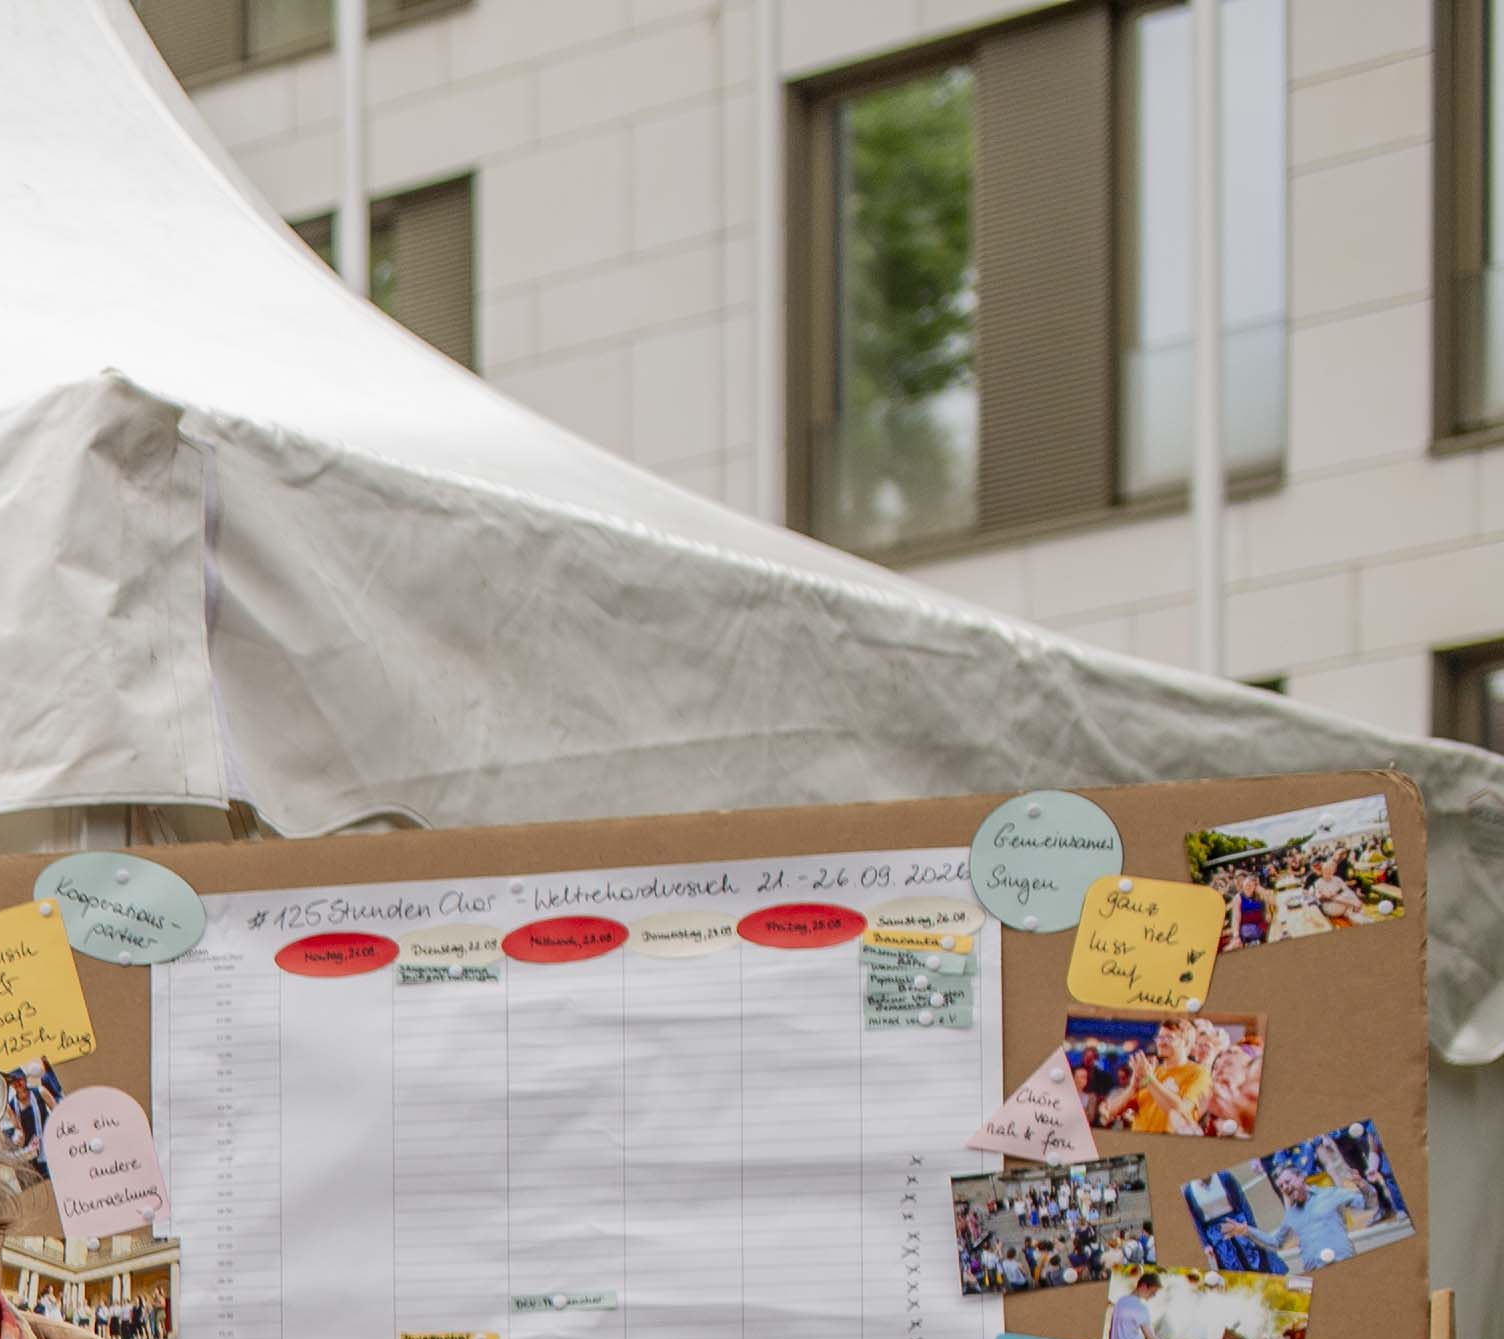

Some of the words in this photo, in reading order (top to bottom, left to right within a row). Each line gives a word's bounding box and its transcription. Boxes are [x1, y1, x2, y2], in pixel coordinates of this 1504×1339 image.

[993, 822, 1115, 852] Gemeinsames
[986, 863, 1059, 903] Singen
[328, 897, 432, 926] Stunden
[440, 888, 497, 916] Chor
[1098, 892, 1162, 920] ganz
[84, 921, 158, 949] partner
[1016, 1088, 1062, 1111] Chöre
[56, 1117, 81, 1139] die
[93, 1116, 120, 1130] ein
[89, 1159, 142, 1180] andere
